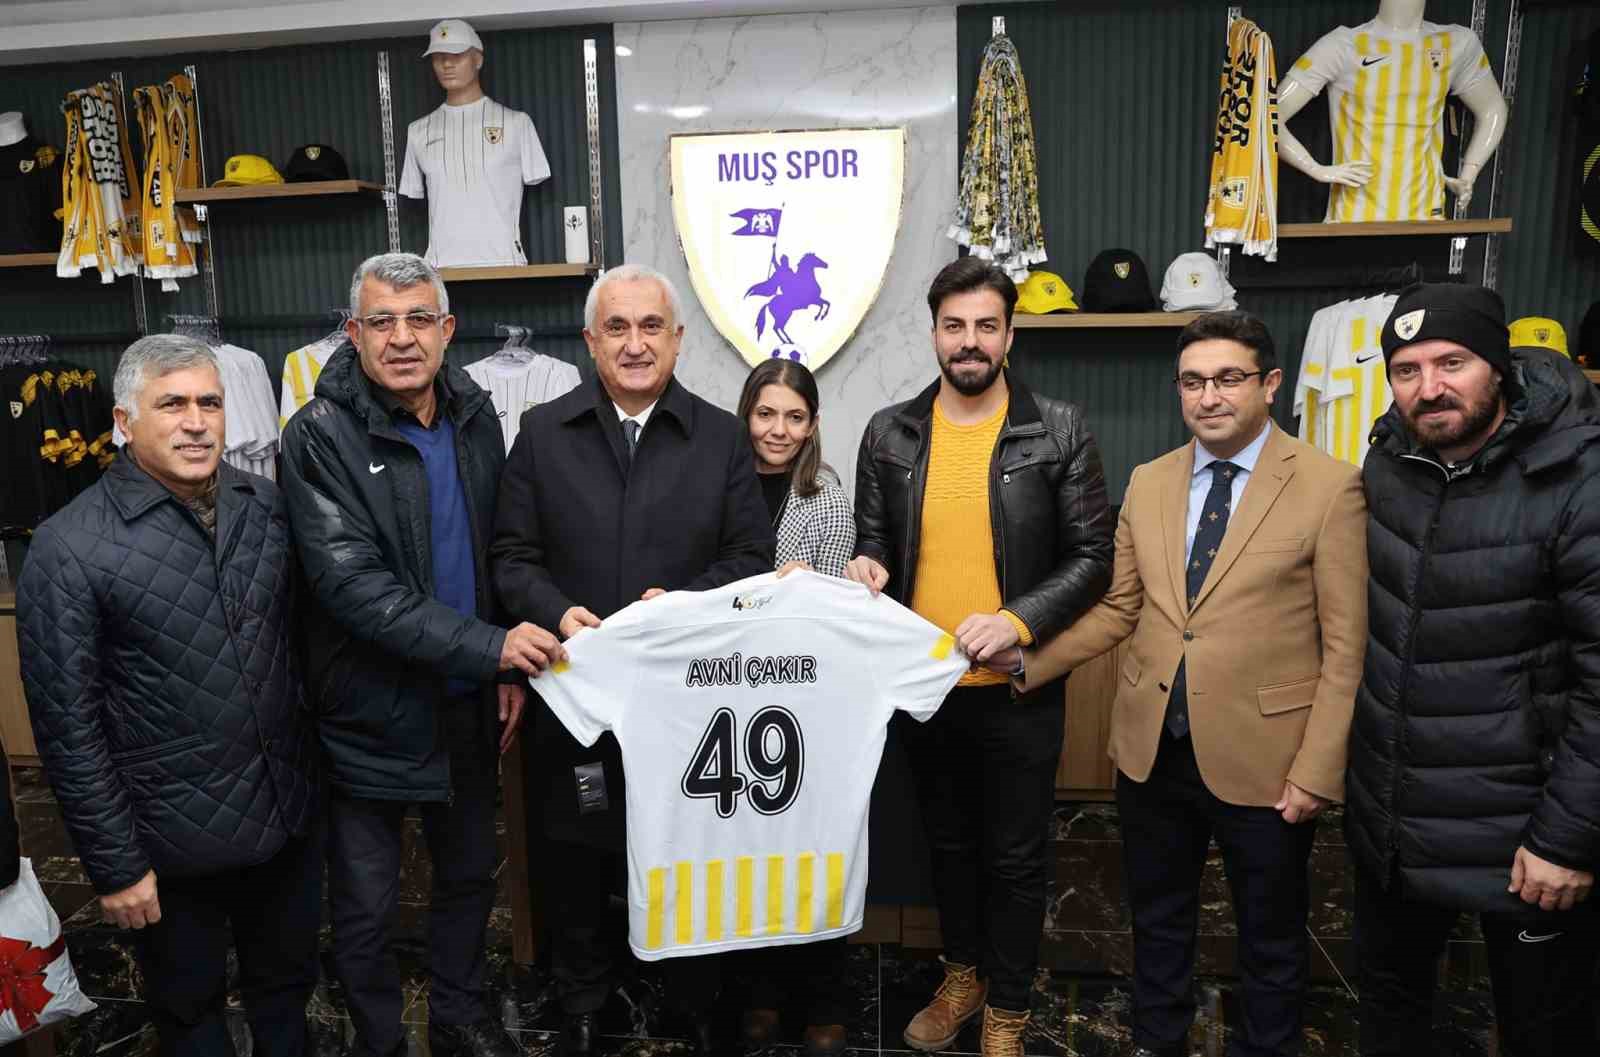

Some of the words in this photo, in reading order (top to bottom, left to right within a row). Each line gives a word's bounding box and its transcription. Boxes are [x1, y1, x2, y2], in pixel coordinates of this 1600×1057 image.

[718, 152, 777, 186] MUŞ
[786, 149, 859, 180] SPOR
[686, 652, 742, 687] AVNİ
[744, 656, 817, 688] ÇAKIR
[681, 705, 805, 819] 49
